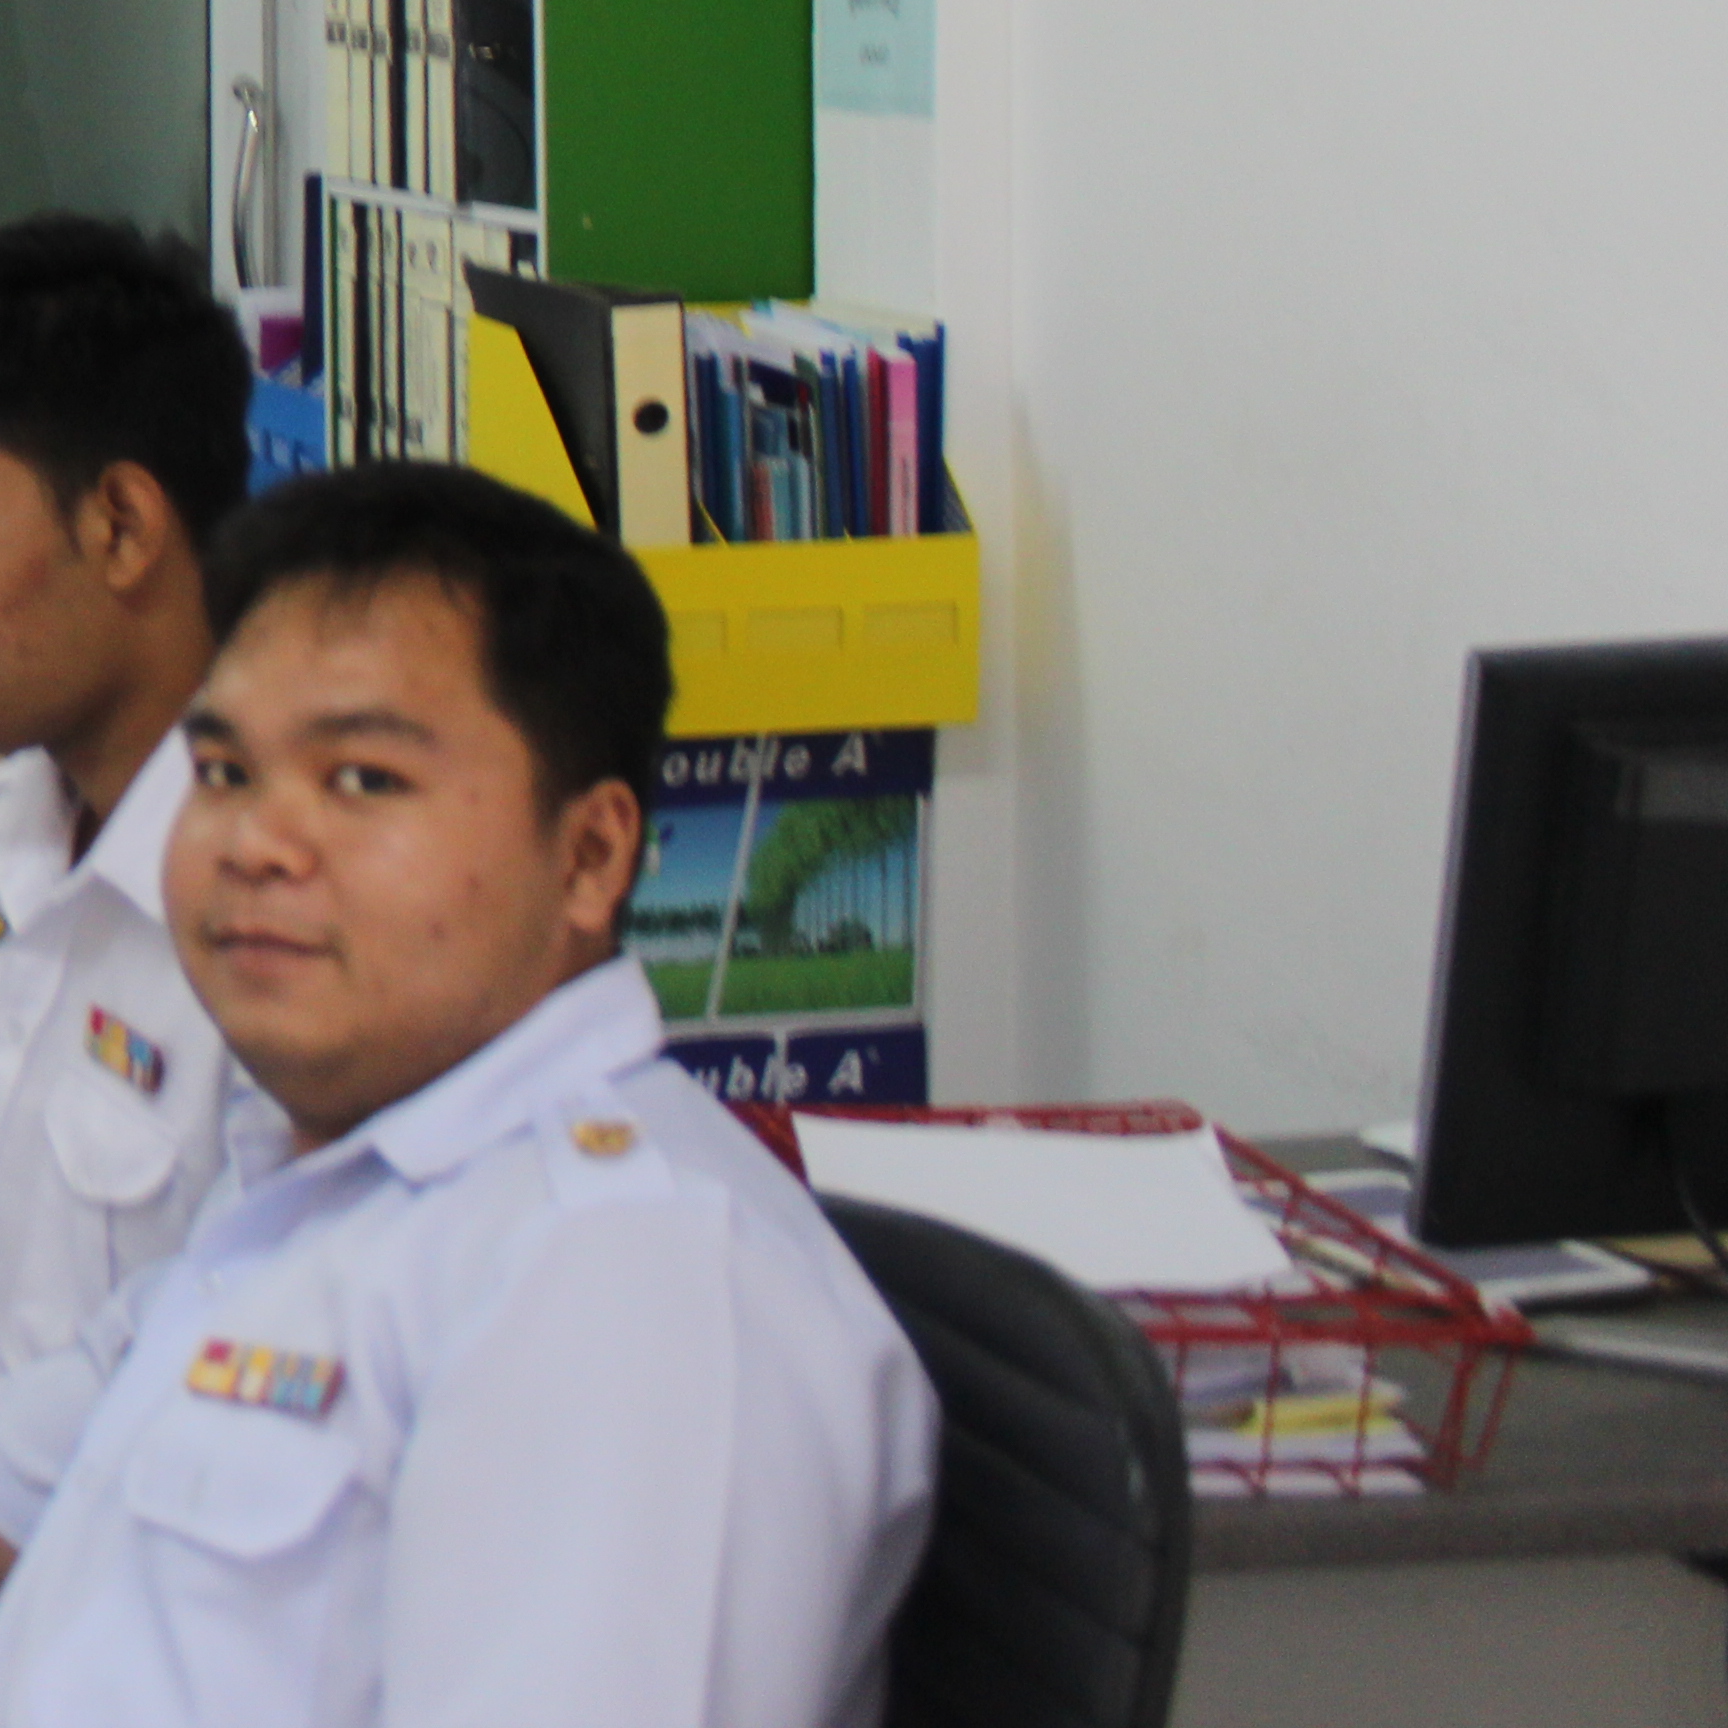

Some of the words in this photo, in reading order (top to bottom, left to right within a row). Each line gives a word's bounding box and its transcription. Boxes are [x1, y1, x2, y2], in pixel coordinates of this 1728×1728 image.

[661, 736, 812, 788] ouble
[831, 729, 868, 775] A
[828, 1048, 865, 1095] A
